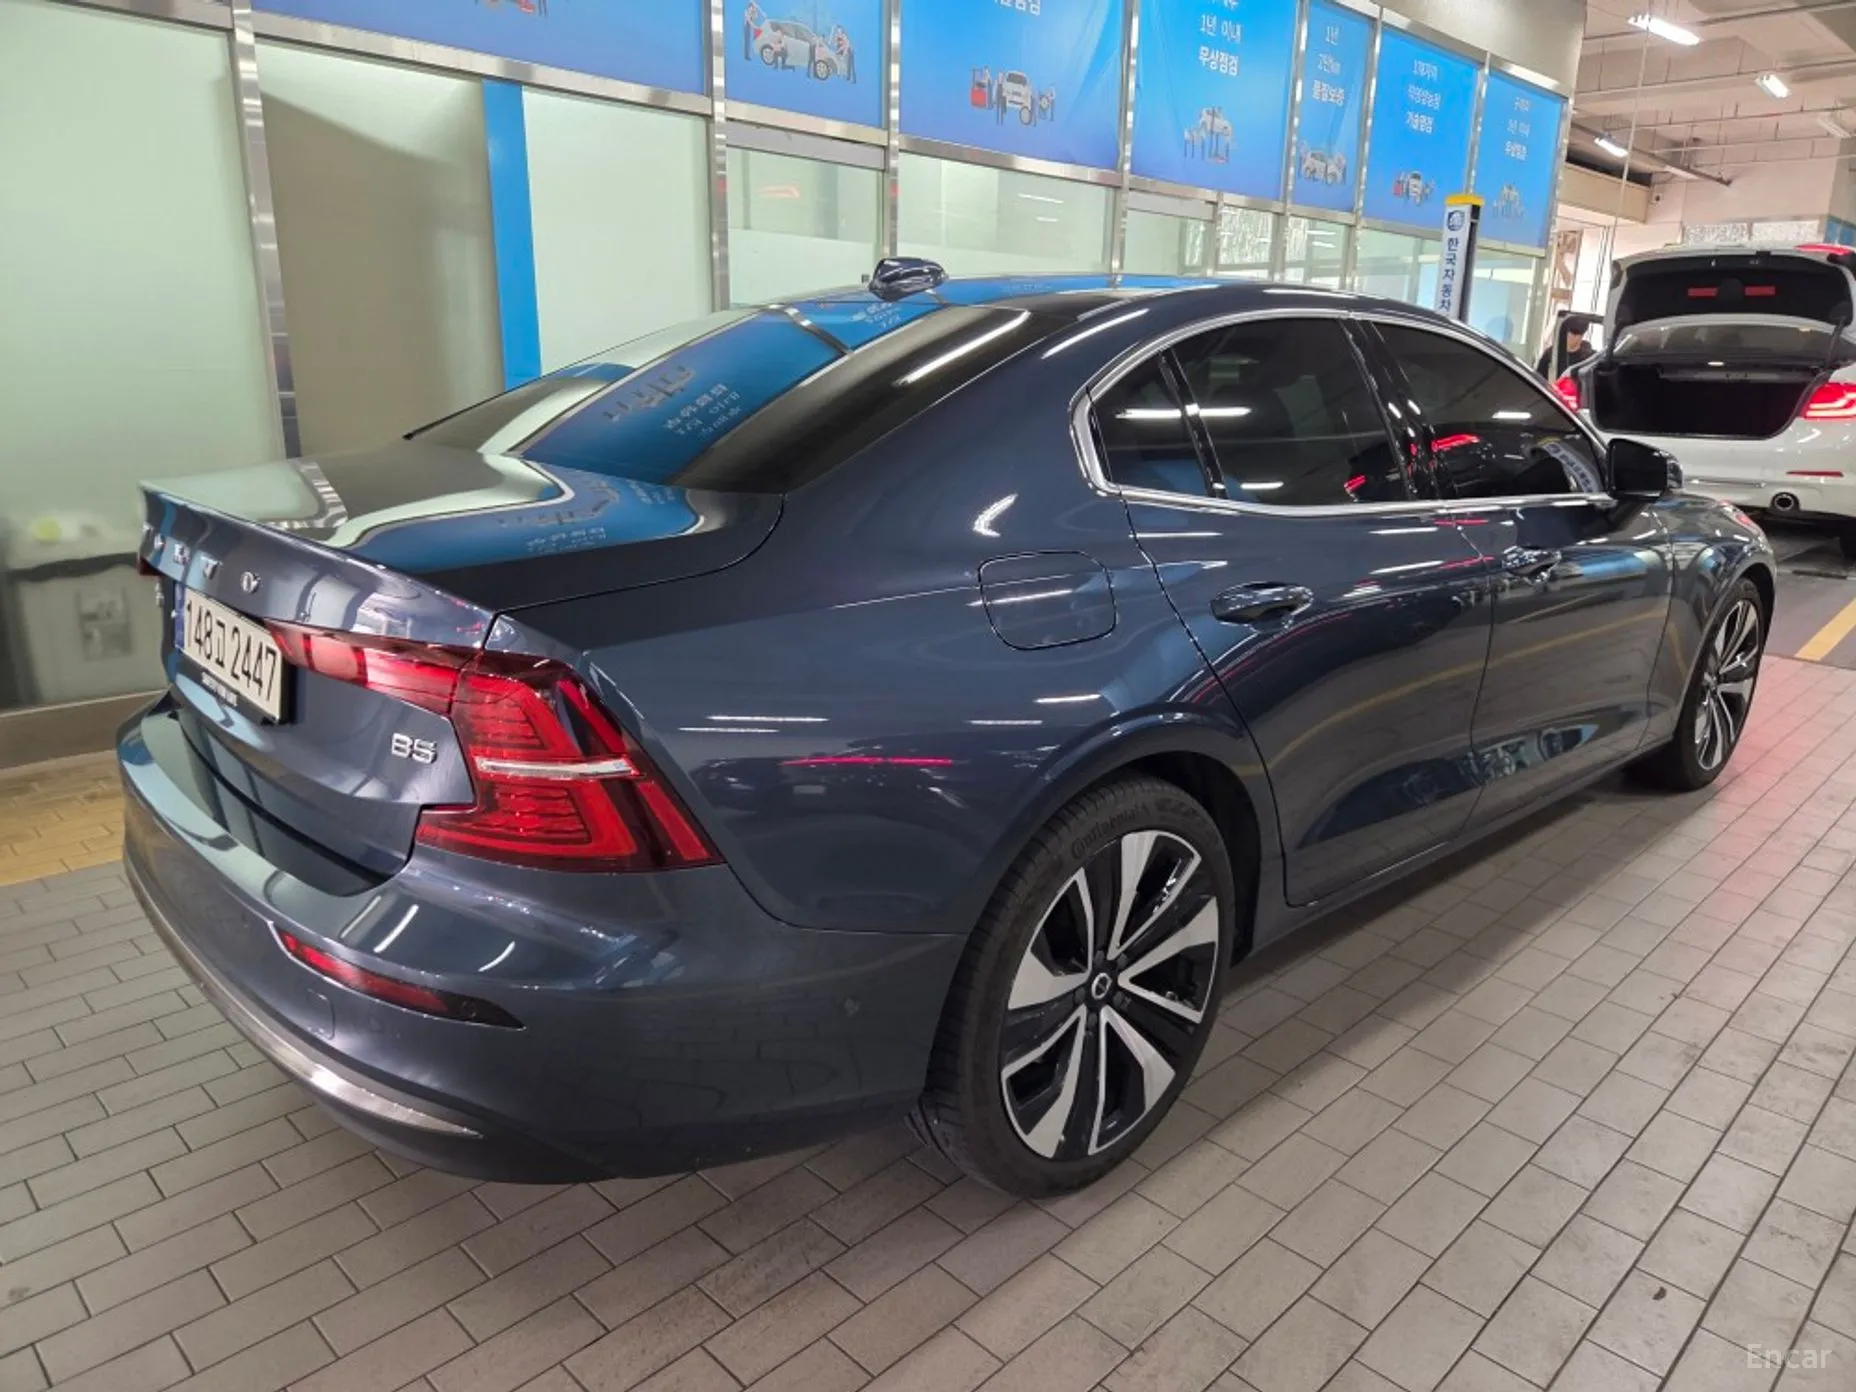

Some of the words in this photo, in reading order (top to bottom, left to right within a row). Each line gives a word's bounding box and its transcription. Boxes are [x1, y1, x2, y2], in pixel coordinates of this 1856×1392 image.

[1200, 14, 1217, 37] 1년
[1221, 20, 1241, 45] 이내
[1198, 46, 1239, 77] 무상점검
[1439, 237, 1460, 312] 한국자동차
[229, 624, 278, 703] 2447
[391, 731, 438, 765] B5
